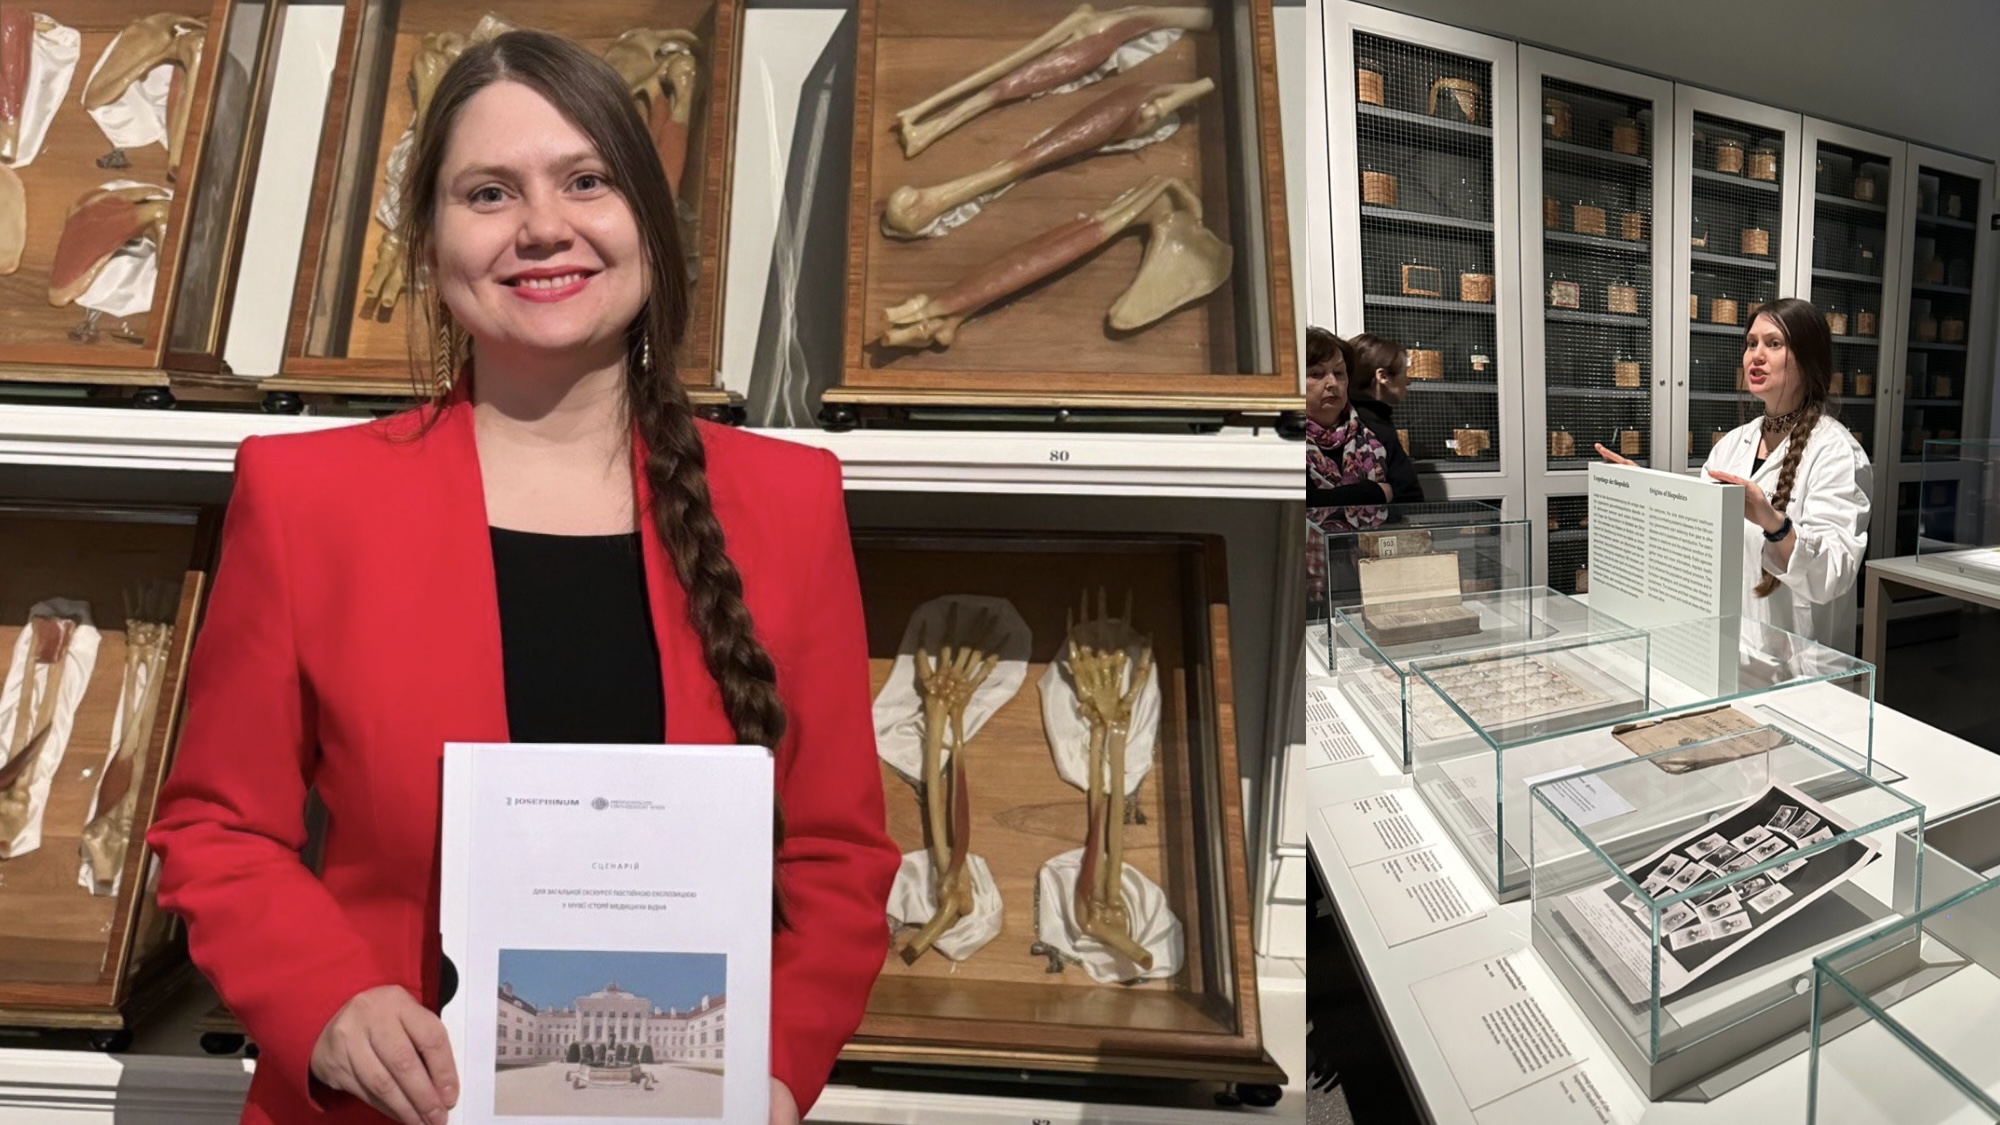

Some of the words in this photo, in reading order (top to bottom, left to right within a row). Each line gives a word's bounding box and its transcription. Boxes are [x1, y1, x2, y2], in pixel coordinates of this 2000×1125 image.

[1049, 450, 1070, 461] 80
[1649, 487, 1663, 496] Origins
[1667, 491, 1688, 501] Biopolitics
[514, 797, 580, 806] JOSEPHINUM
[591, 861, 640, 870] СЦЕНАРІЙ
